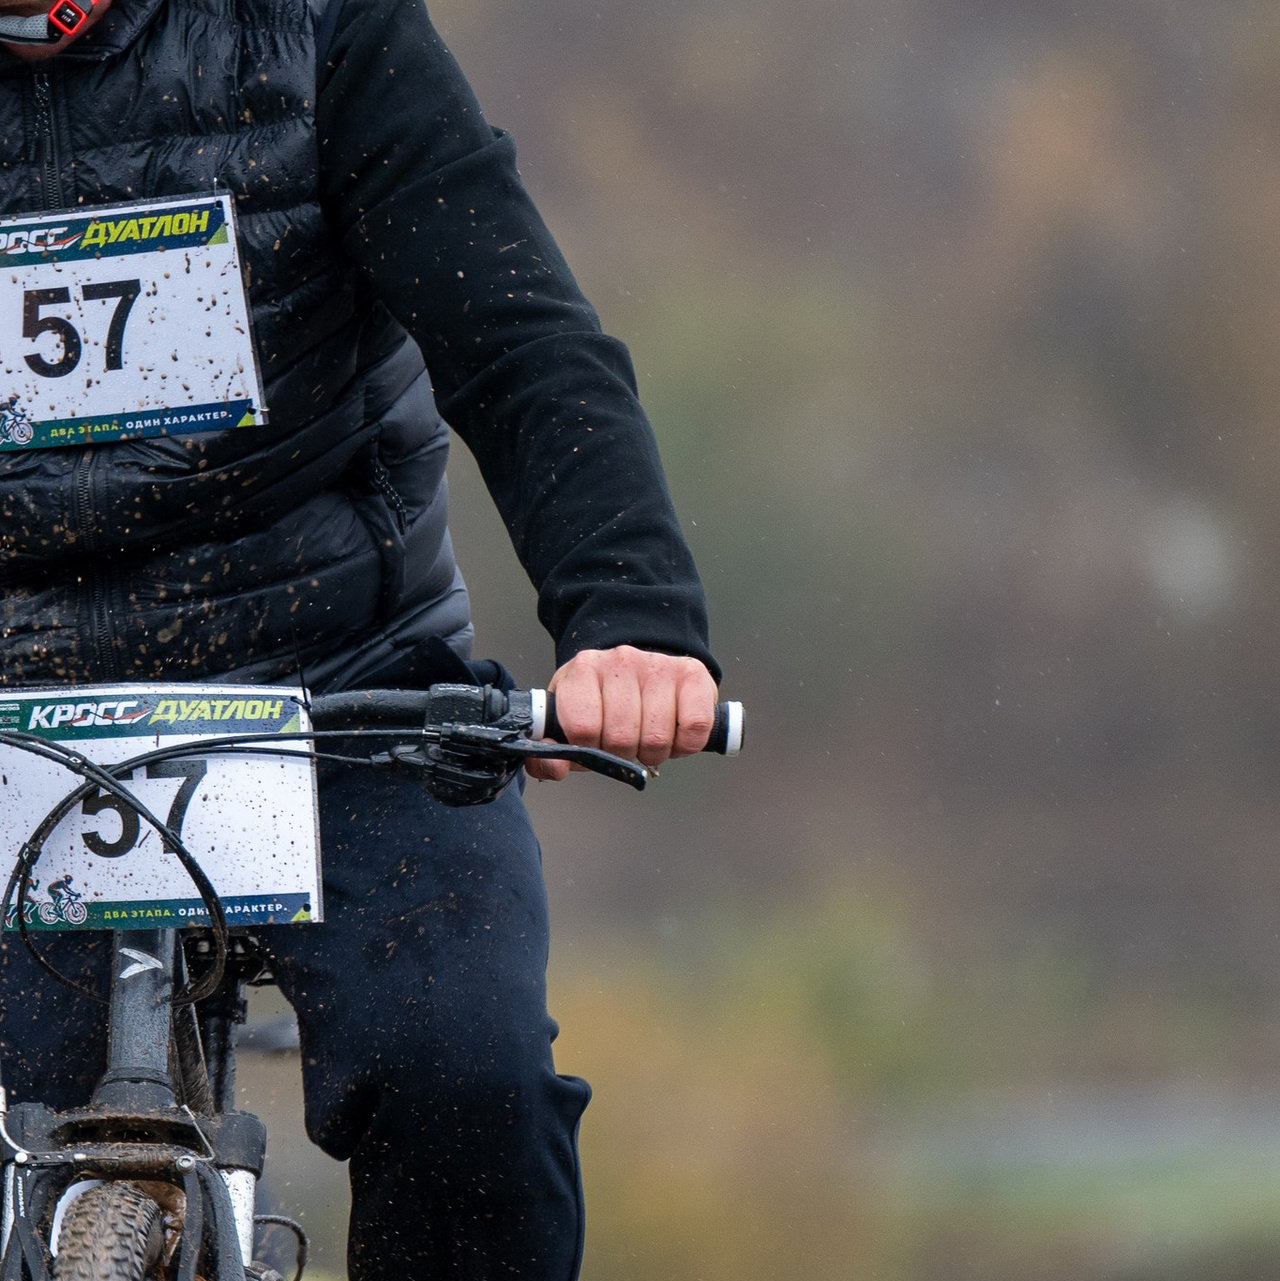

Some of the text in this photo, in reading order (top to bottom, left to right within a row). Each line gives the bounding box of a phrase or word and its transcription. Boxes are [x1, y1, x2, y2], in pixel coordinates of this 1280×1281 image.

[79, 210, 210, 251] ДУАТЛОН
[21, 277, 142, 379] 57
[50, 410, 233, 438] ДВА ЭТАПА. ОДИН ХАРАКТЕР.
[28, 699, 284, 730] КРОСС ДУАТЛОН
[80, 759, 208, 859] 57
[104, 910, 128, 920] ДВА
[131, 908, 176, 918] ЭТАПА.
[221, 903, 288, 914] АРАКТЕР.
[17, 1176, 26, 1218] PROMAX
